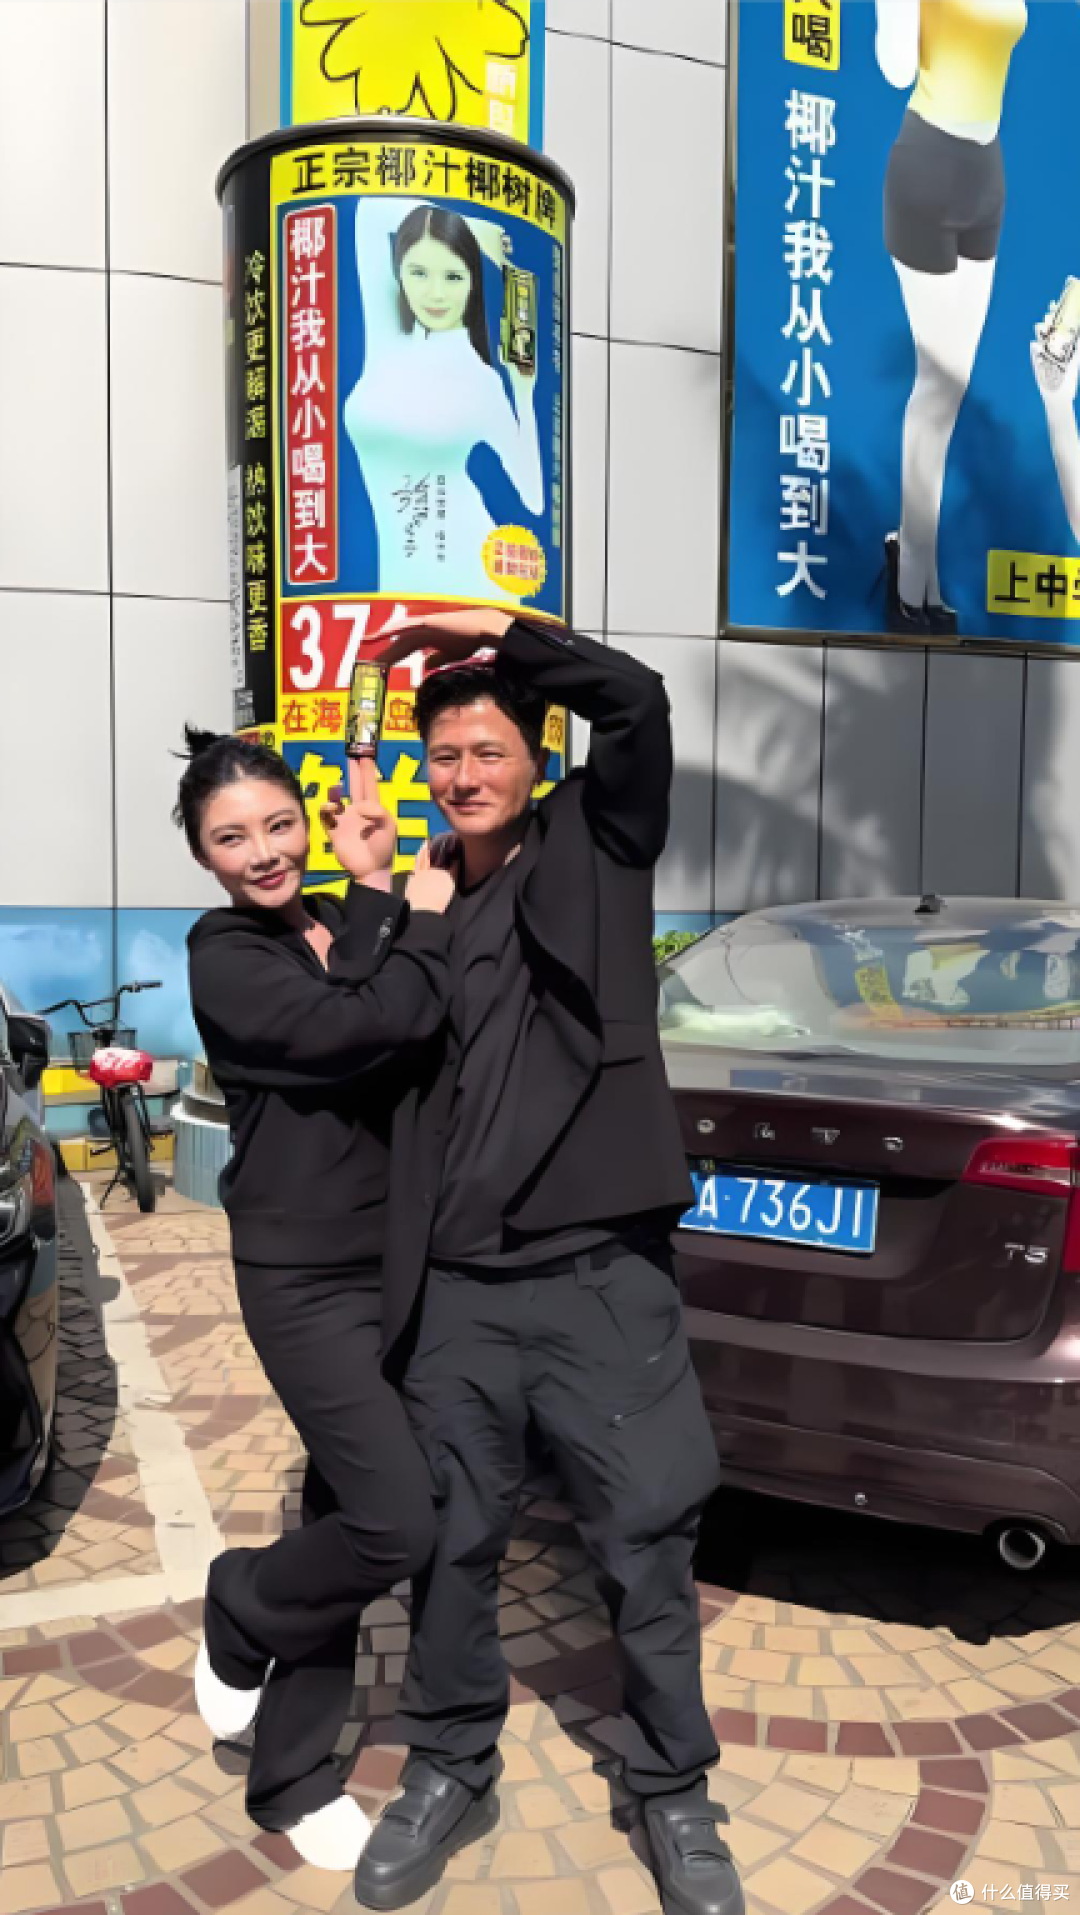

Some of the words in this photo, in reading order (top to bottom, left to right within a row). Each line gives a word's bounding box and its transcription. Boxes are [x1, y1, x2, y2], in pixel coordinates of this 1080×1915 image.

[791, 0, 833, 63] 喝
[292, 145, 557, 231] 正宗椰汁椰树牌
[289, 215, 329, 577] 椰汁我从小喝到大
[775, 88, 836, 600] 椰汁我从小喝到大
[244, 461, 268, 653] 热饮味更香
[283, 697, 418, 735] 在海岛
